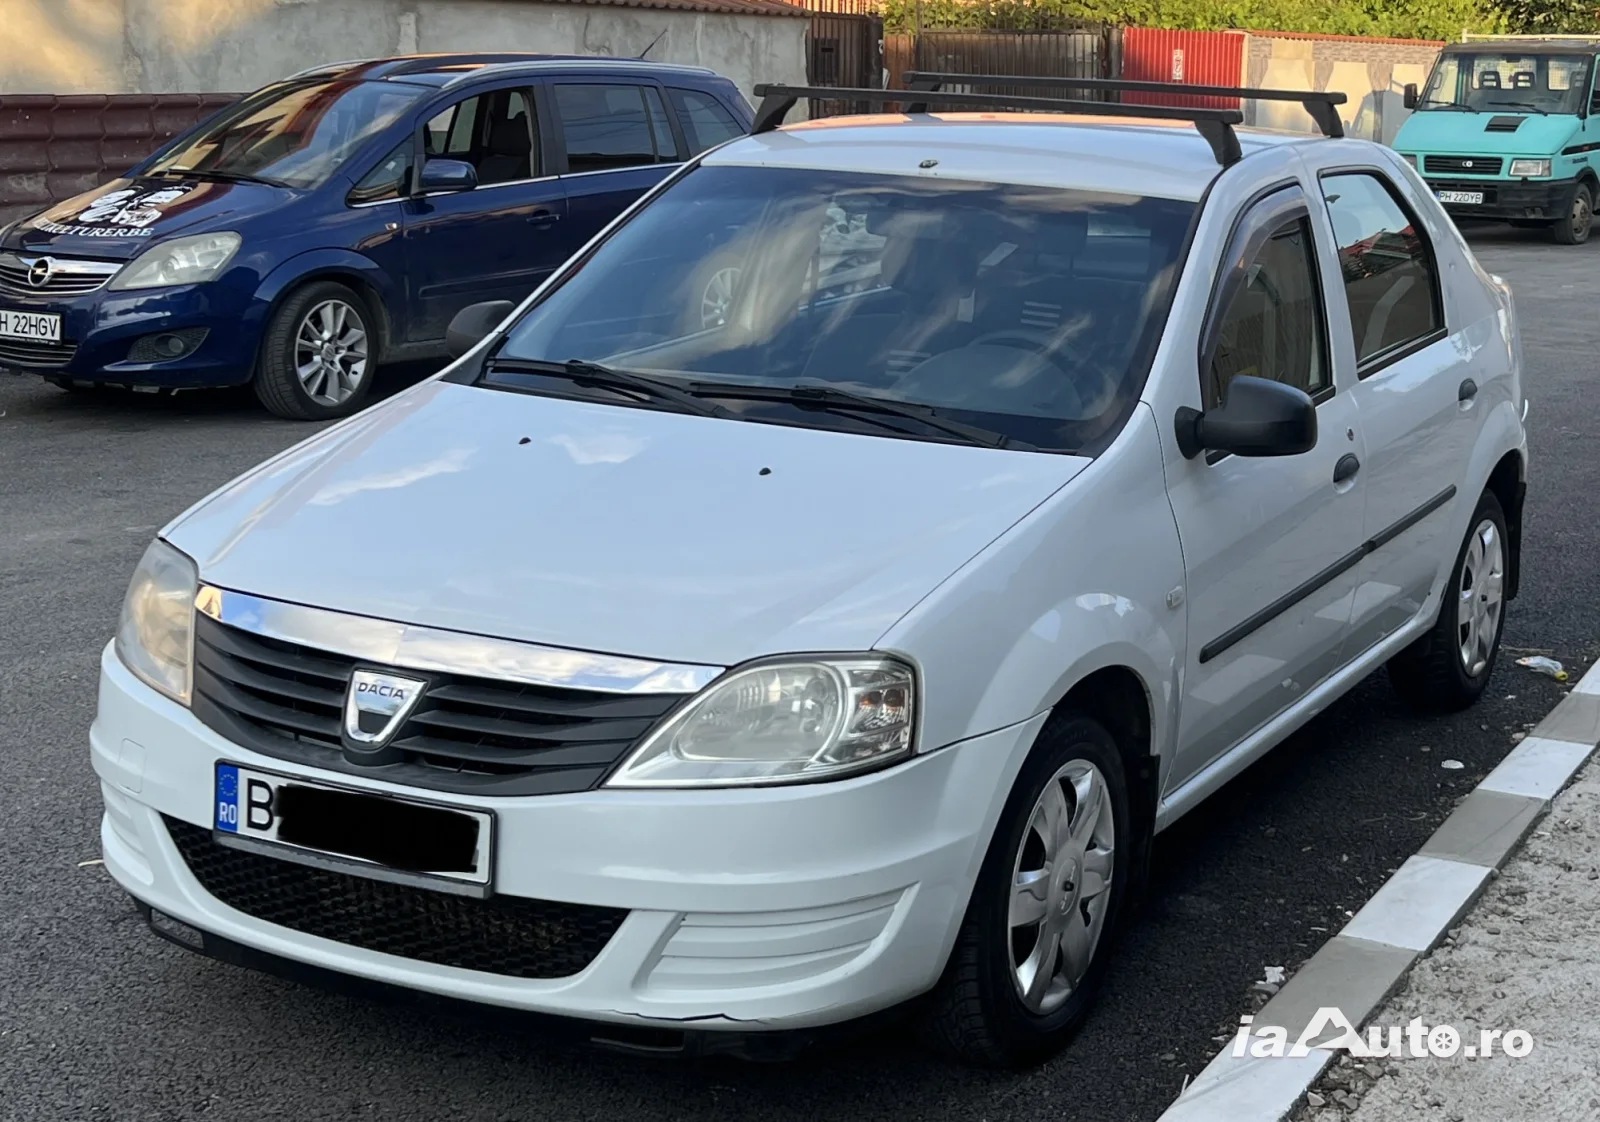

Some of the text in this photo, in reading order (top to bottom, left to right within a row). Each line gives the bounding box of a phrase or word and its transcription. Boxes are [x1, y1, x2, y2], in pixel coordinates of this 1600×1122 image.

[1440, 191, 1451, 201] PH
[13, 314, 58, 338] 22HGV
[358, 682, 404, 700] DACIA
[219, 777, 275, 832] RO B
